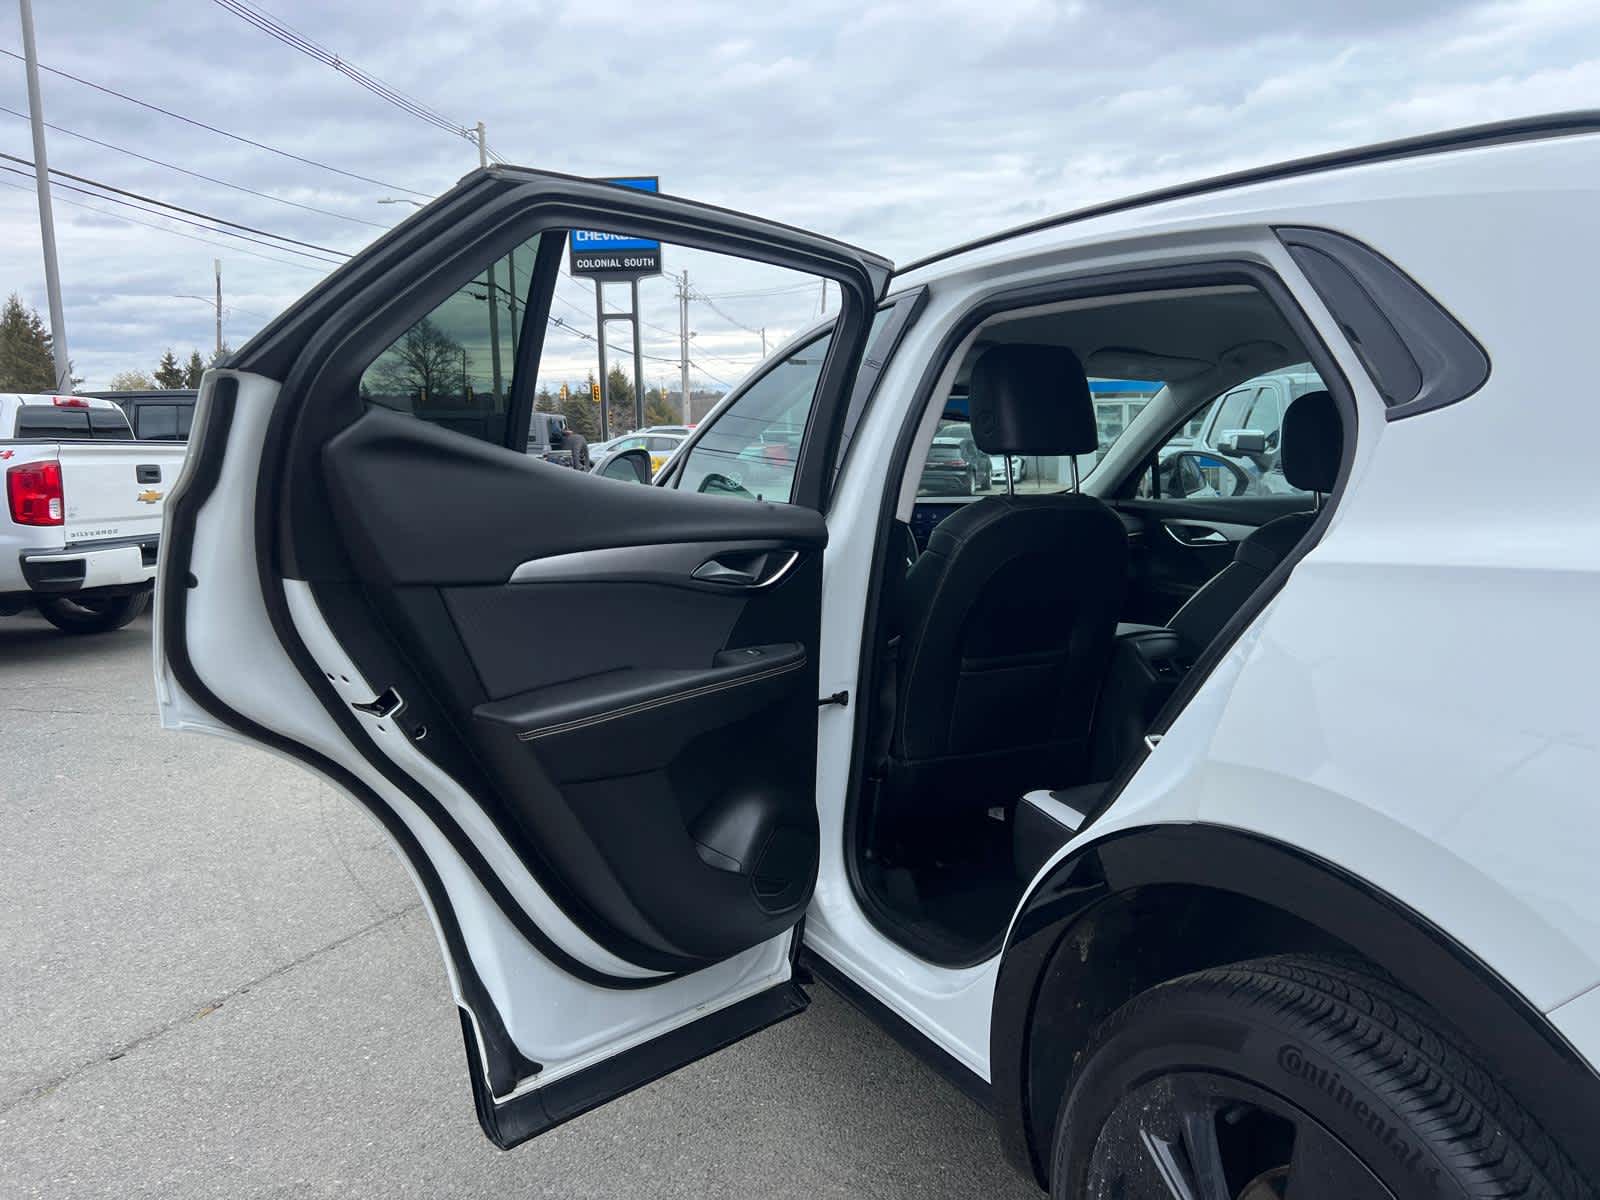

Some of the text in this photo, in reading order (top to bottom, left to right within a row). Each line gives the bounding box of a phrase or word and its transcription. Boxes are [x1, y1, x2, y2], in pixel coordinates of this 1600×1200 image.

[576, 257, 655, 268] COLONIAL SOUTH
[1277, 1044, 1424, 1170] Continental
